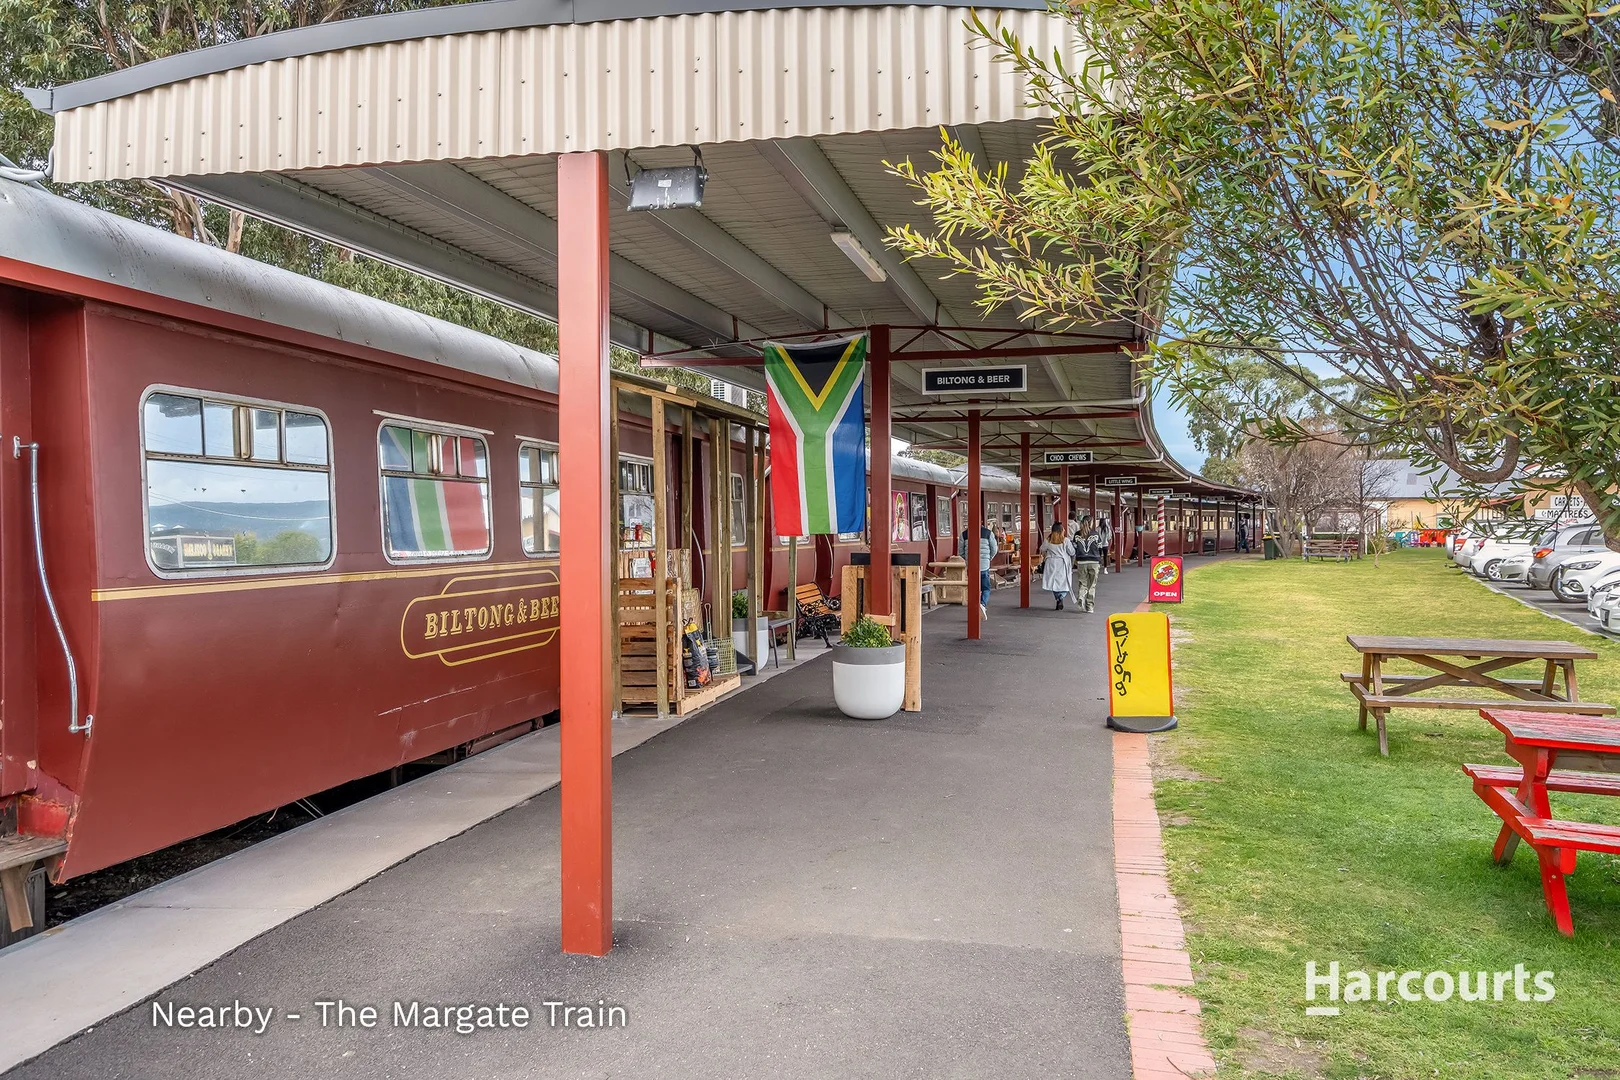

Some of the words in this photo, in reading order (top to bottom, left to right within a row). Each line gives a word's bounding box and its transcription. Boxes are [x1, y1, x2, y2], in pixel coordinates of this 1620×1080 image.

[937, 376, 975, 385] BILTONG
[977, 376, 985, 384] &
[987, 375, 1010, 384] BEER
[1050, 454, 1064, 462] CHOO
[1068, 453, 1087, 461] CHEWS
[1554, 496, 1580, 507] CARETS
[424, 603, 515, 640] BILTONG
[517, 598, 528, 624] &
[529, 595, 560, 621] BEE
[1110, 620, 1132, 697] Biltong
